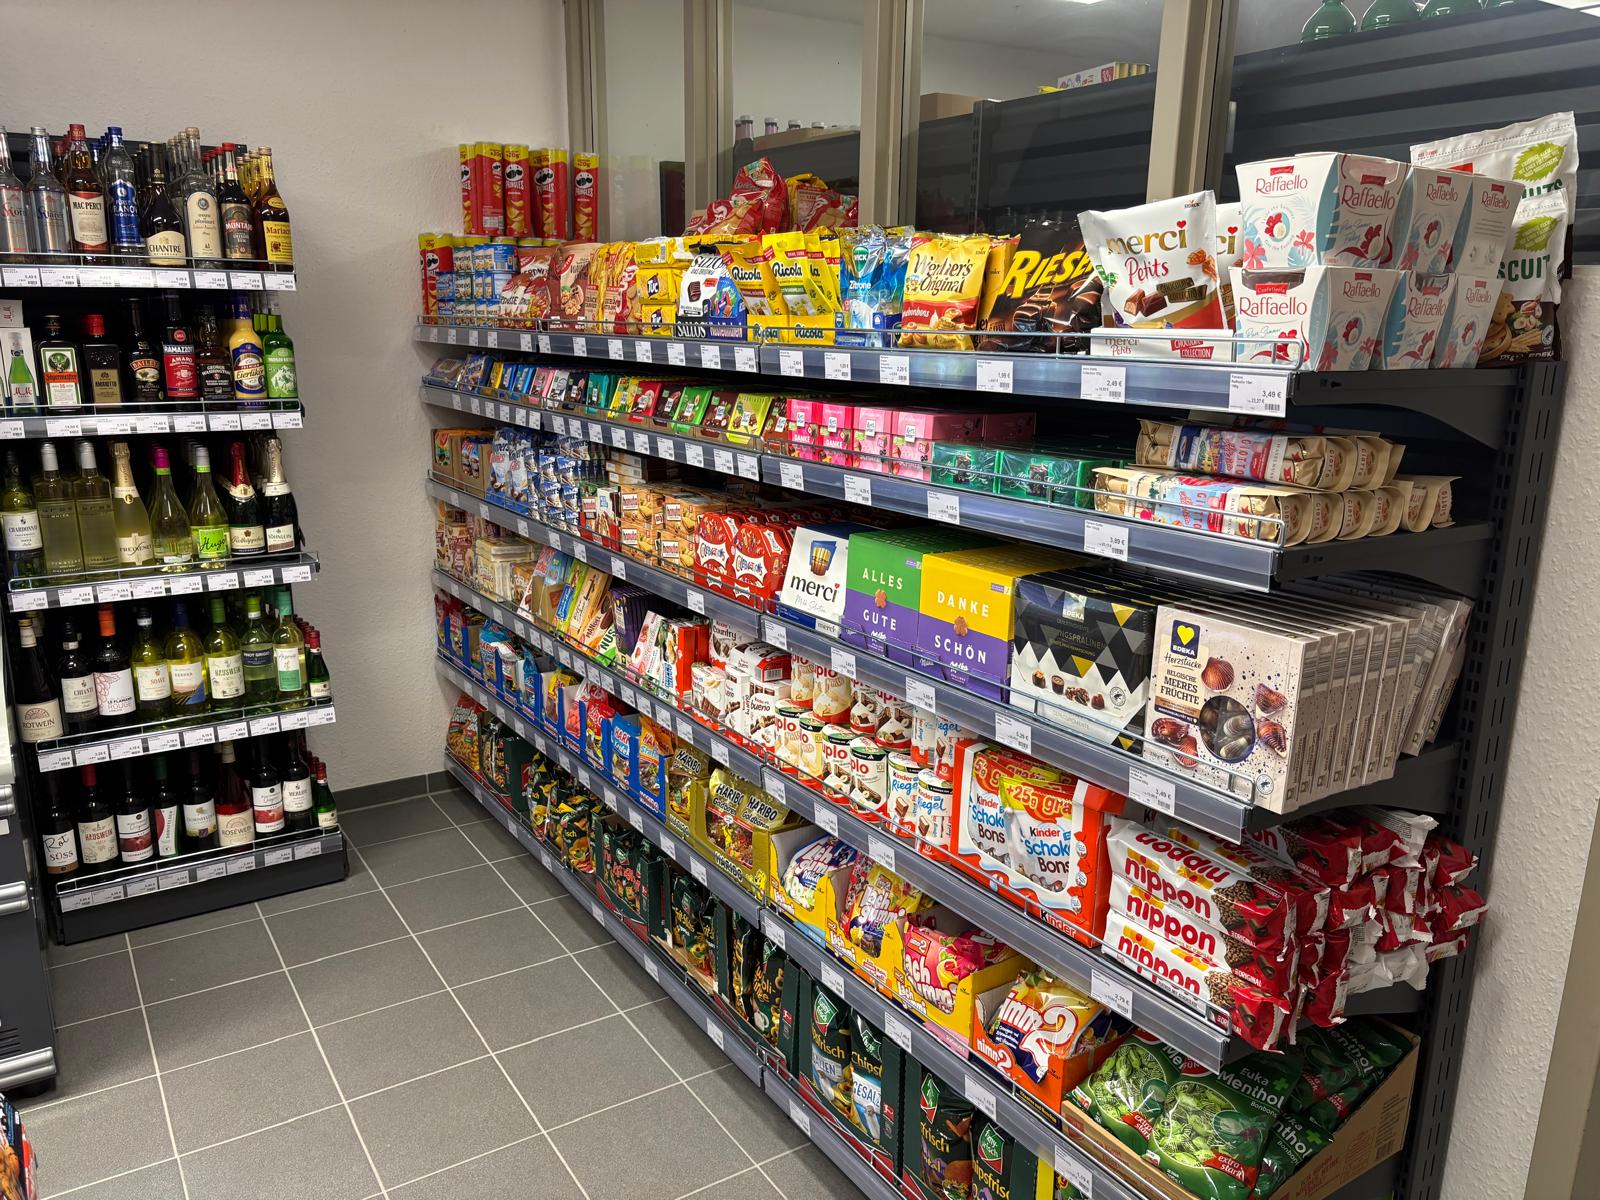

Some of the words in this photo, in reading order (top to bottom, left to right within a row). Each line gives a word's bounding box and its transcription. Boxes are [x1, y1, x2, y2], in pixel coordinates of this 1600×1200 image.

[1255, 174, 1308, 194] Raffaello
[1426, 184, 1458, 202] Raffaello
[1341, 184, 1396, 210] Raffaello
[1480, 193, 1511, 210] Raffaello
[1105, 222, 1187, 255] merci
[731, 266, 762, 281] Ricola
[772, 262, 803, 277] Ricola
[1001, 250, 1095, 298] RIESE
[1124, 256, 1170, 285] Petits
[849, 280, 872, 290] Zitrone
[919, 275, 965, 295] Original
[1342, 280, 1381, 298] Raffaello
[1239, 297, 1308, 318] Raffaello
[1406, 299, 1447, 318] Raffaello
[1262, 390, 1276, 398] 3,49
[199, 537, 226, 551] Hugo
[862, 567, 904, 590] ALLES
[790, 573, 839, 603] merci
[936, 590, 990, 617] DANKE
[863, 609, 897, 631] GUTE
[1062, 609, 1085, 621] EDEKA
[934, 634, 987, 664] SCHÖN
[1172, 645, 1195, 656] EDEKA
[1164, 652, 1202, 669] Herzstücke
[1163, 676, 1198, 693] MEERES
[1166, 669, 1197, 683] BELGISCHE
[1160, 685, 1200, 705] FRÜCHTE
[750, 698, 771, 711] bueno
[822, 743, 848, 760] uplo
[892, 780, 918, 795] Riege
[747, 797, 778, 820] HARIBO
[978, 823, 1005, 843] Bons
[1029, 826, 1060, 837] Kinder
[1038, 857, 1070, 874] Bons
[1135, 831, 1231, 883] nippon
[1124, 857, 1211, 919] nippon
[1126, 892, 1216, 956] nippon
[1117, 930, 1201, 996] nippon
[1241, 1066, 1270, 1086] Euka
[1218, 1070, 1285, 1108] Menthol
[1250, 1101, 1279, 1118] Bonbons
[1134, 1113, 1153, 1131] extra
[1218, 1154, 1240, 1170] extra
[1220, 1162, 1245, 1180] stark
